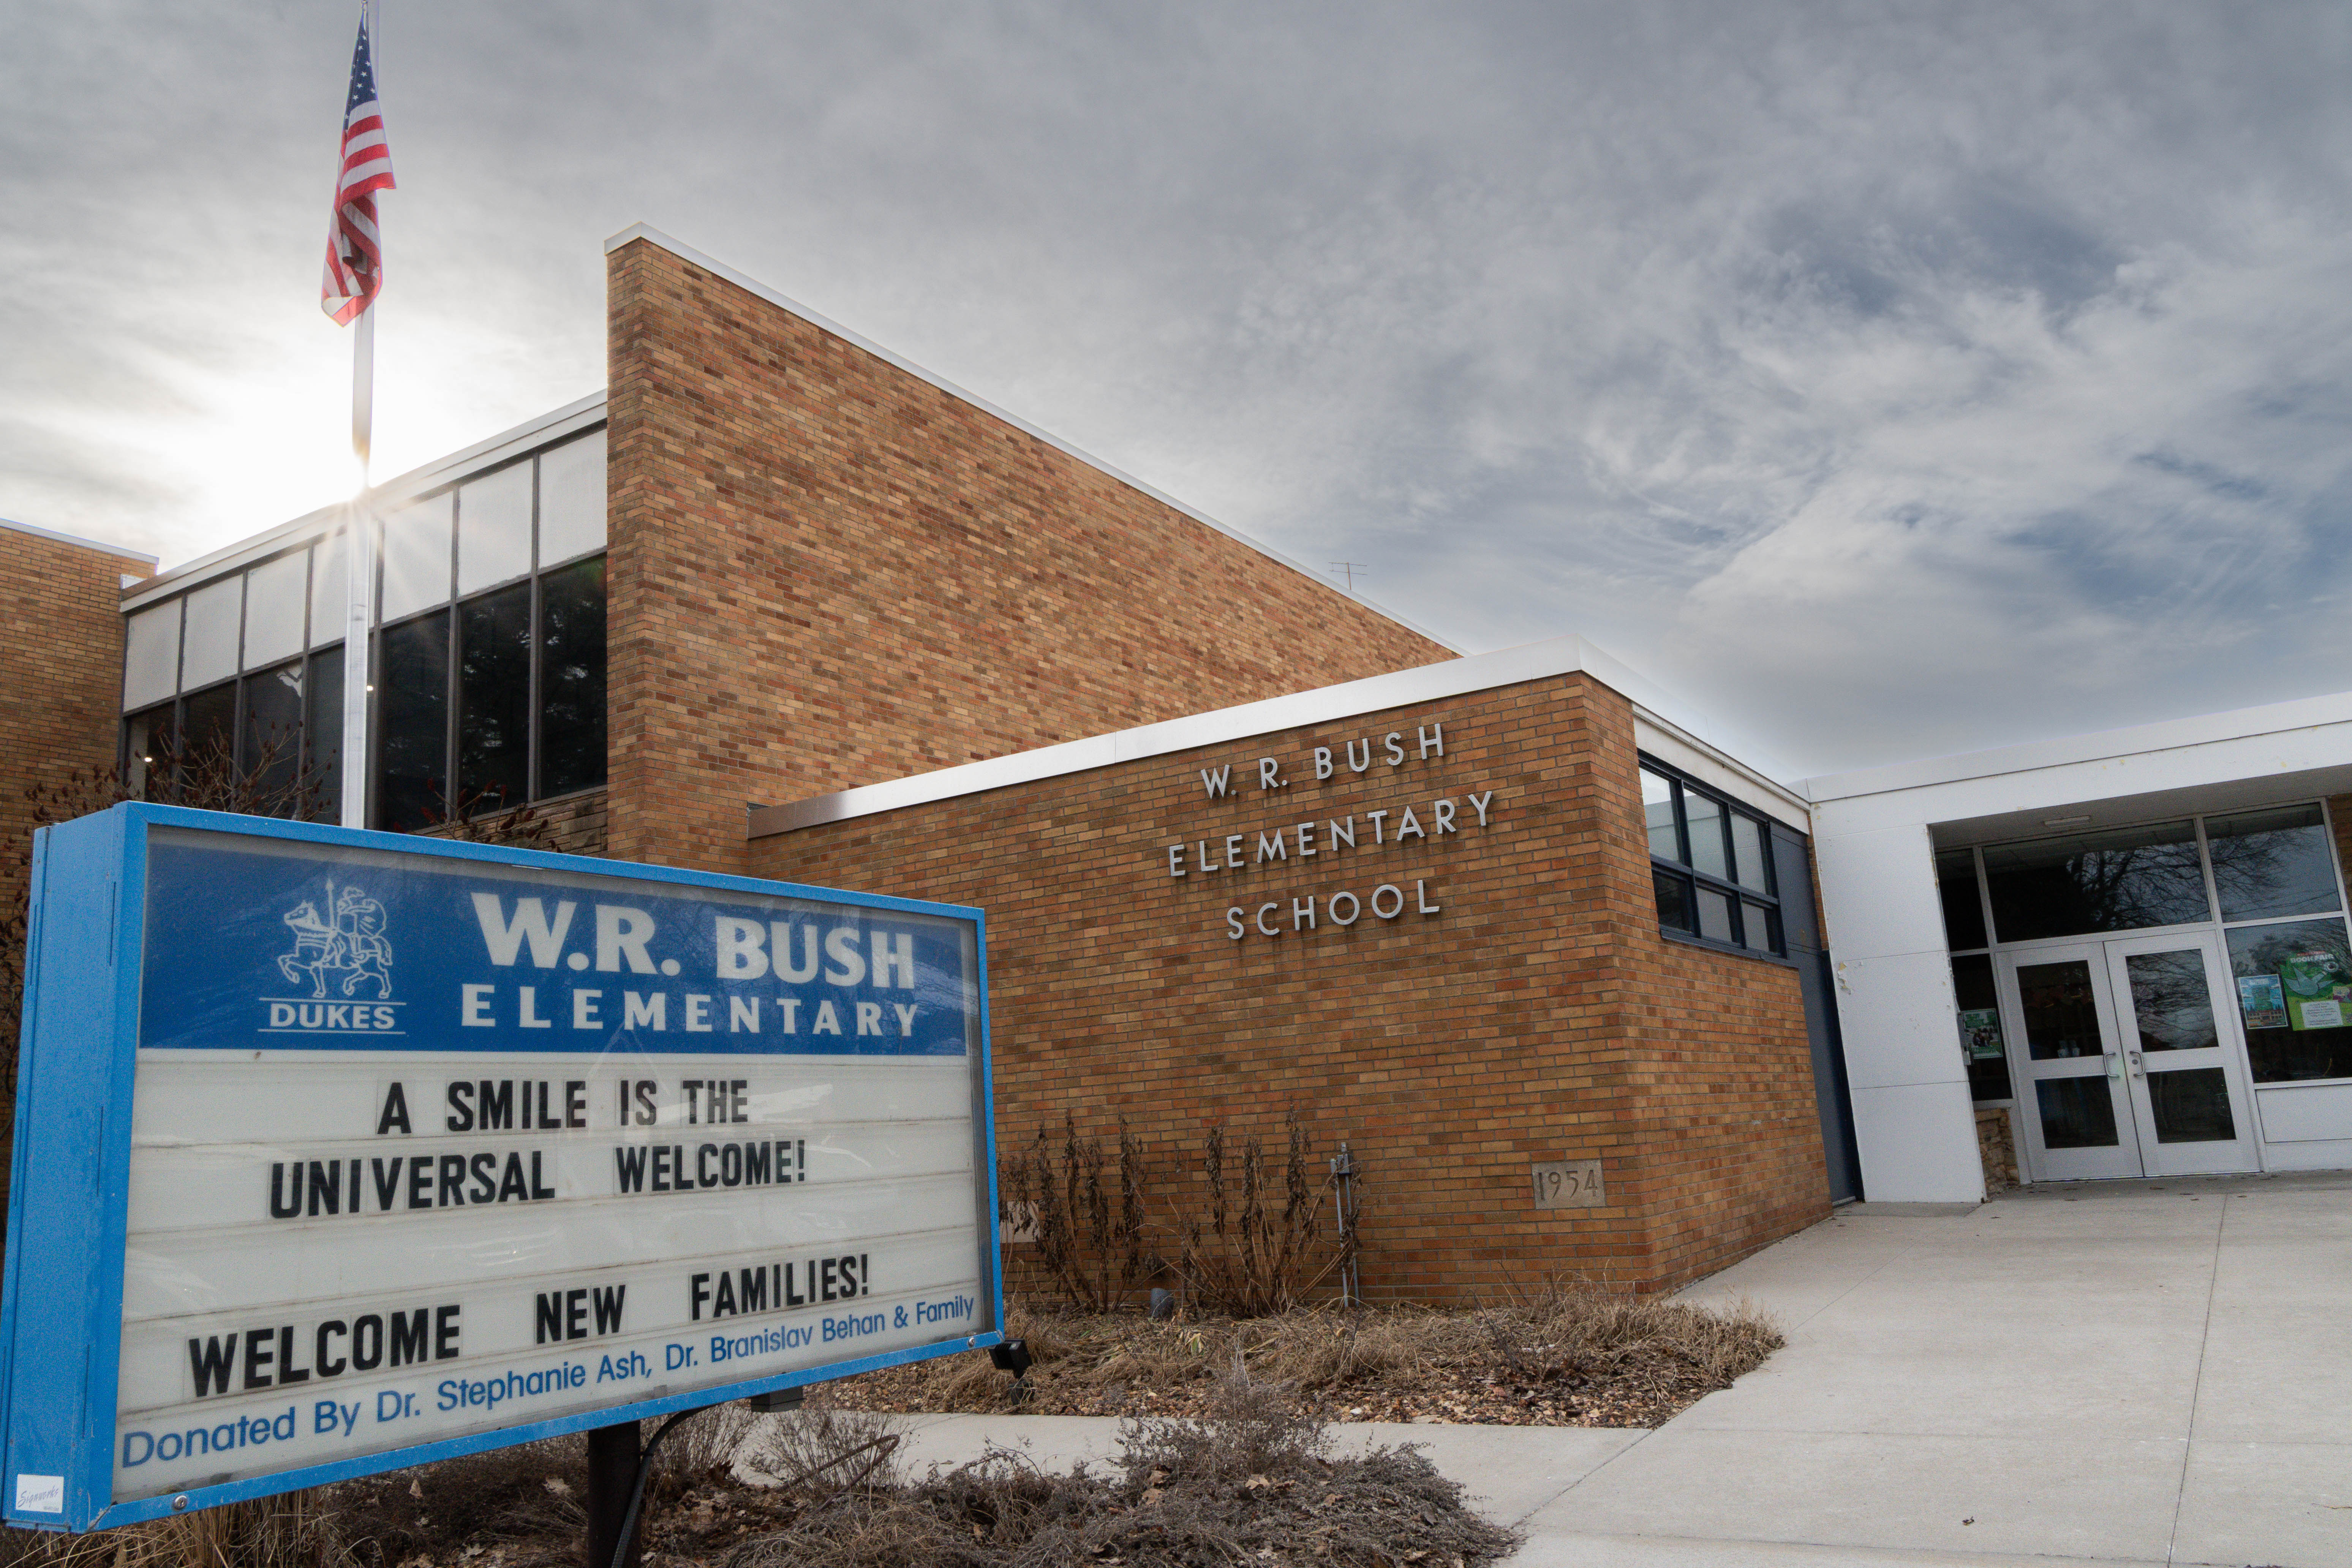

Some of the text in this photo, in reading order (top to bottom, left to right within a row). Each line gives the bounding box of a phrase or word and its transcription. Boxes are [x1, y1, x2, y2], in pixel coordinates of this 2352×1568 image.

[1200, 723, 1444, 799] W. R. BUSH
[1169, 790, 1493, 877] ELEMENTARY
[470, 892, 915, 988] W.R. BUSH
[1226, 880, 1440, 940] SCHOOL
[270, 1003, 395, 1029] DUKES
[461, 983, 917, 1037] ELEMENTARY
[377, 1080, 748, 1135] A SMILE IS THE
[270, 1140, 805, 1219] UNIVERSAL WELCOME!
[1538, 1169, 1598, 1200] 1954
[188, 1253, 868, 1397] WELCOME NEW FAMILIES!
[122, 1295, 974, 1468] Donated By Dr. Stephanie Ash, Dr. Branislav Behan & Family
[18, 1485, 59, 1508] Signworks
